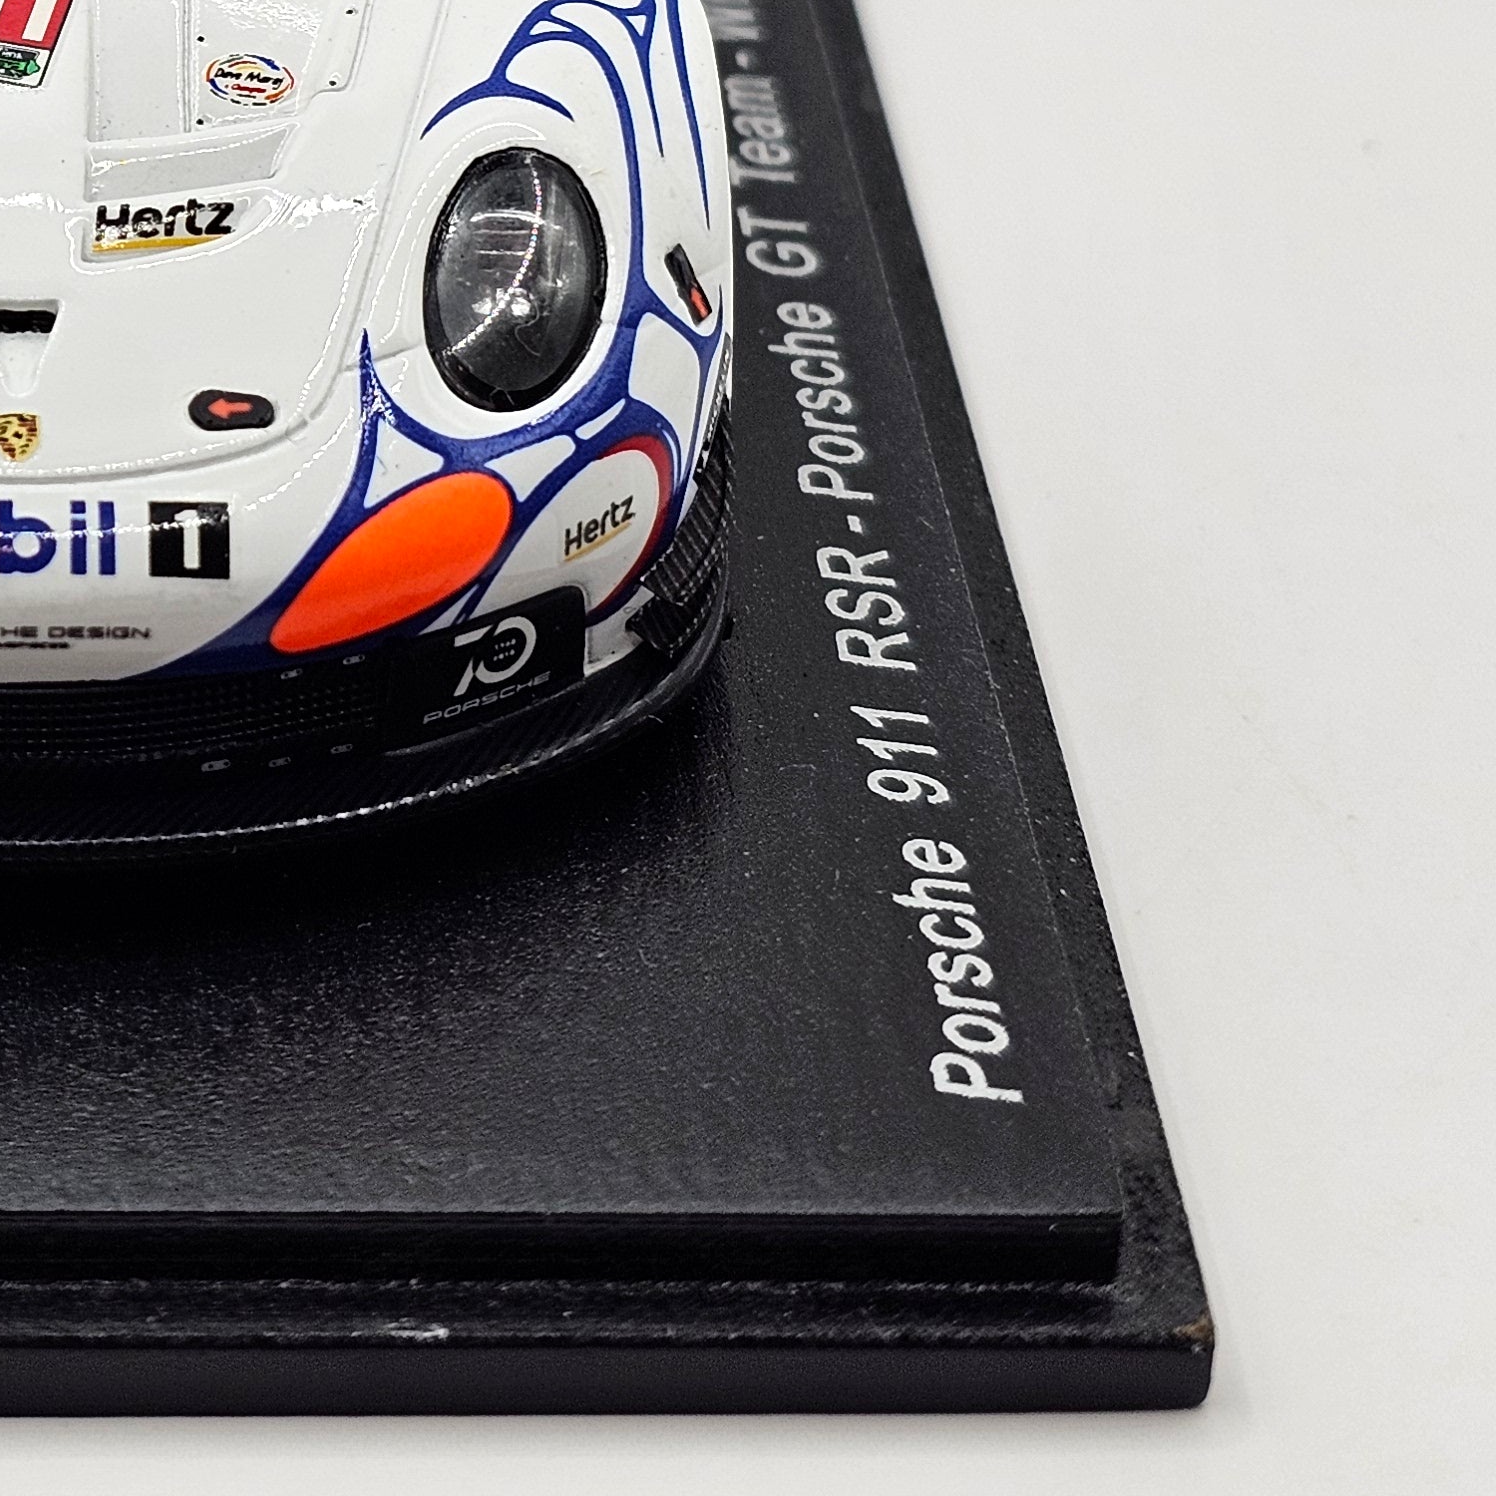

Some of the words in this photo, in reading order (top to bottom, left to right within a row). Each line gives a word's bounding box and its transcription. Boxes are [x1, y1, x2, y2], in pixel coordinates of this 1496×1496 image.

[725, 74, 796, 186] Team
[94, 198, 236, 242] Hertz
[736, 205, 820, 278] GT
[564, 494, 637, 557] Hertz
[47, 625, 152, 639] DESIGN
[422, 670, 552, 725] PORSCHE
[849, 705, 951, 805] 911
[891, 836, 1025, 1104] Porsche
